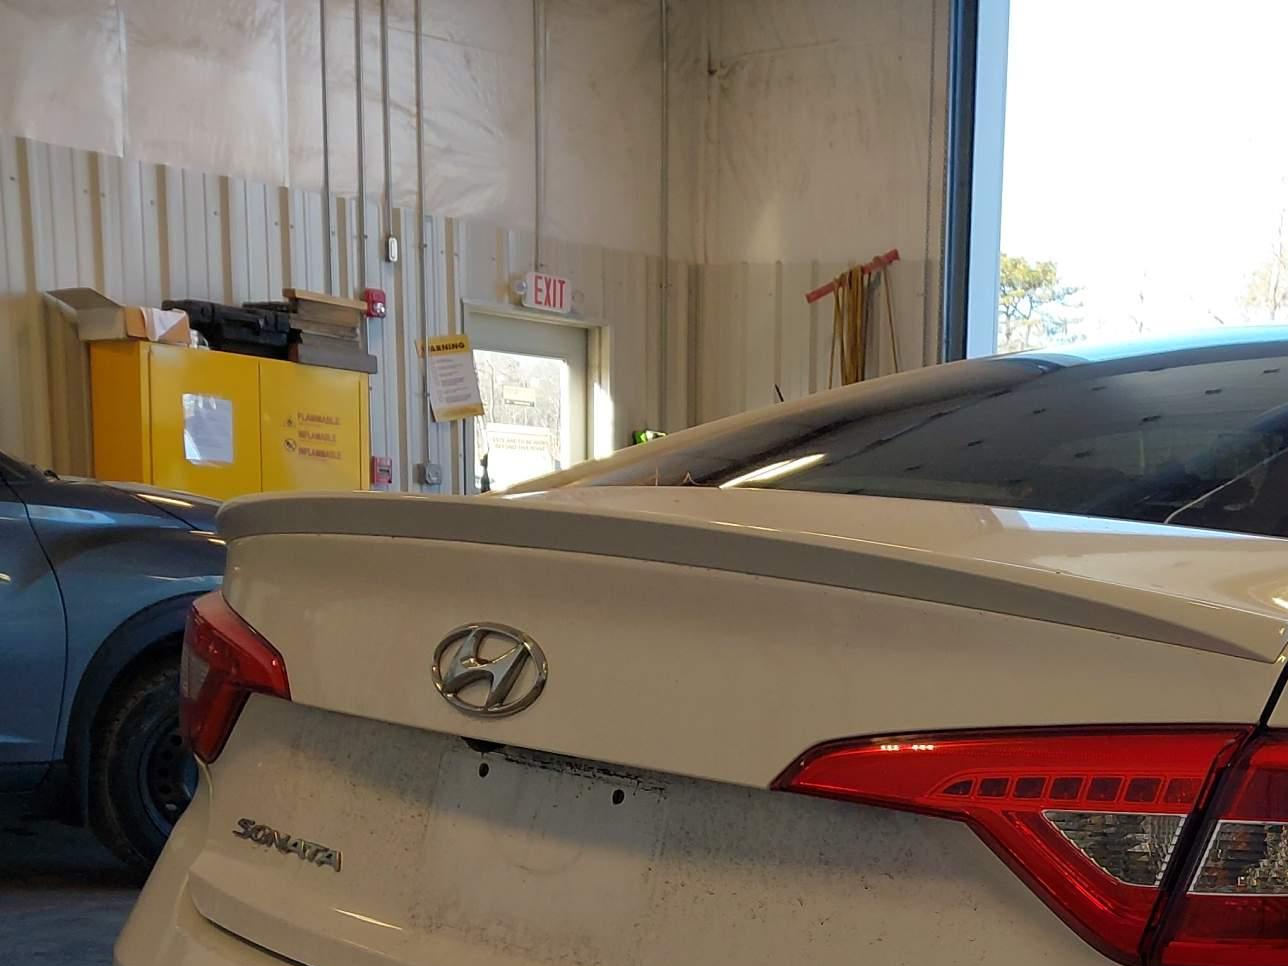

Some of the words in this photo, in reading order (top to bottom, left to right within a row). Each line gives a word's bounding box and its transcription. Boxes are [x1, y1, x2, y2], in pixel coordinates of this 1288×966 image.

[534, 275, 566, 308] EXIT
[297, 412, 341, 425] FLAMMABLE
[232, 818, 342, 872] SONATA
